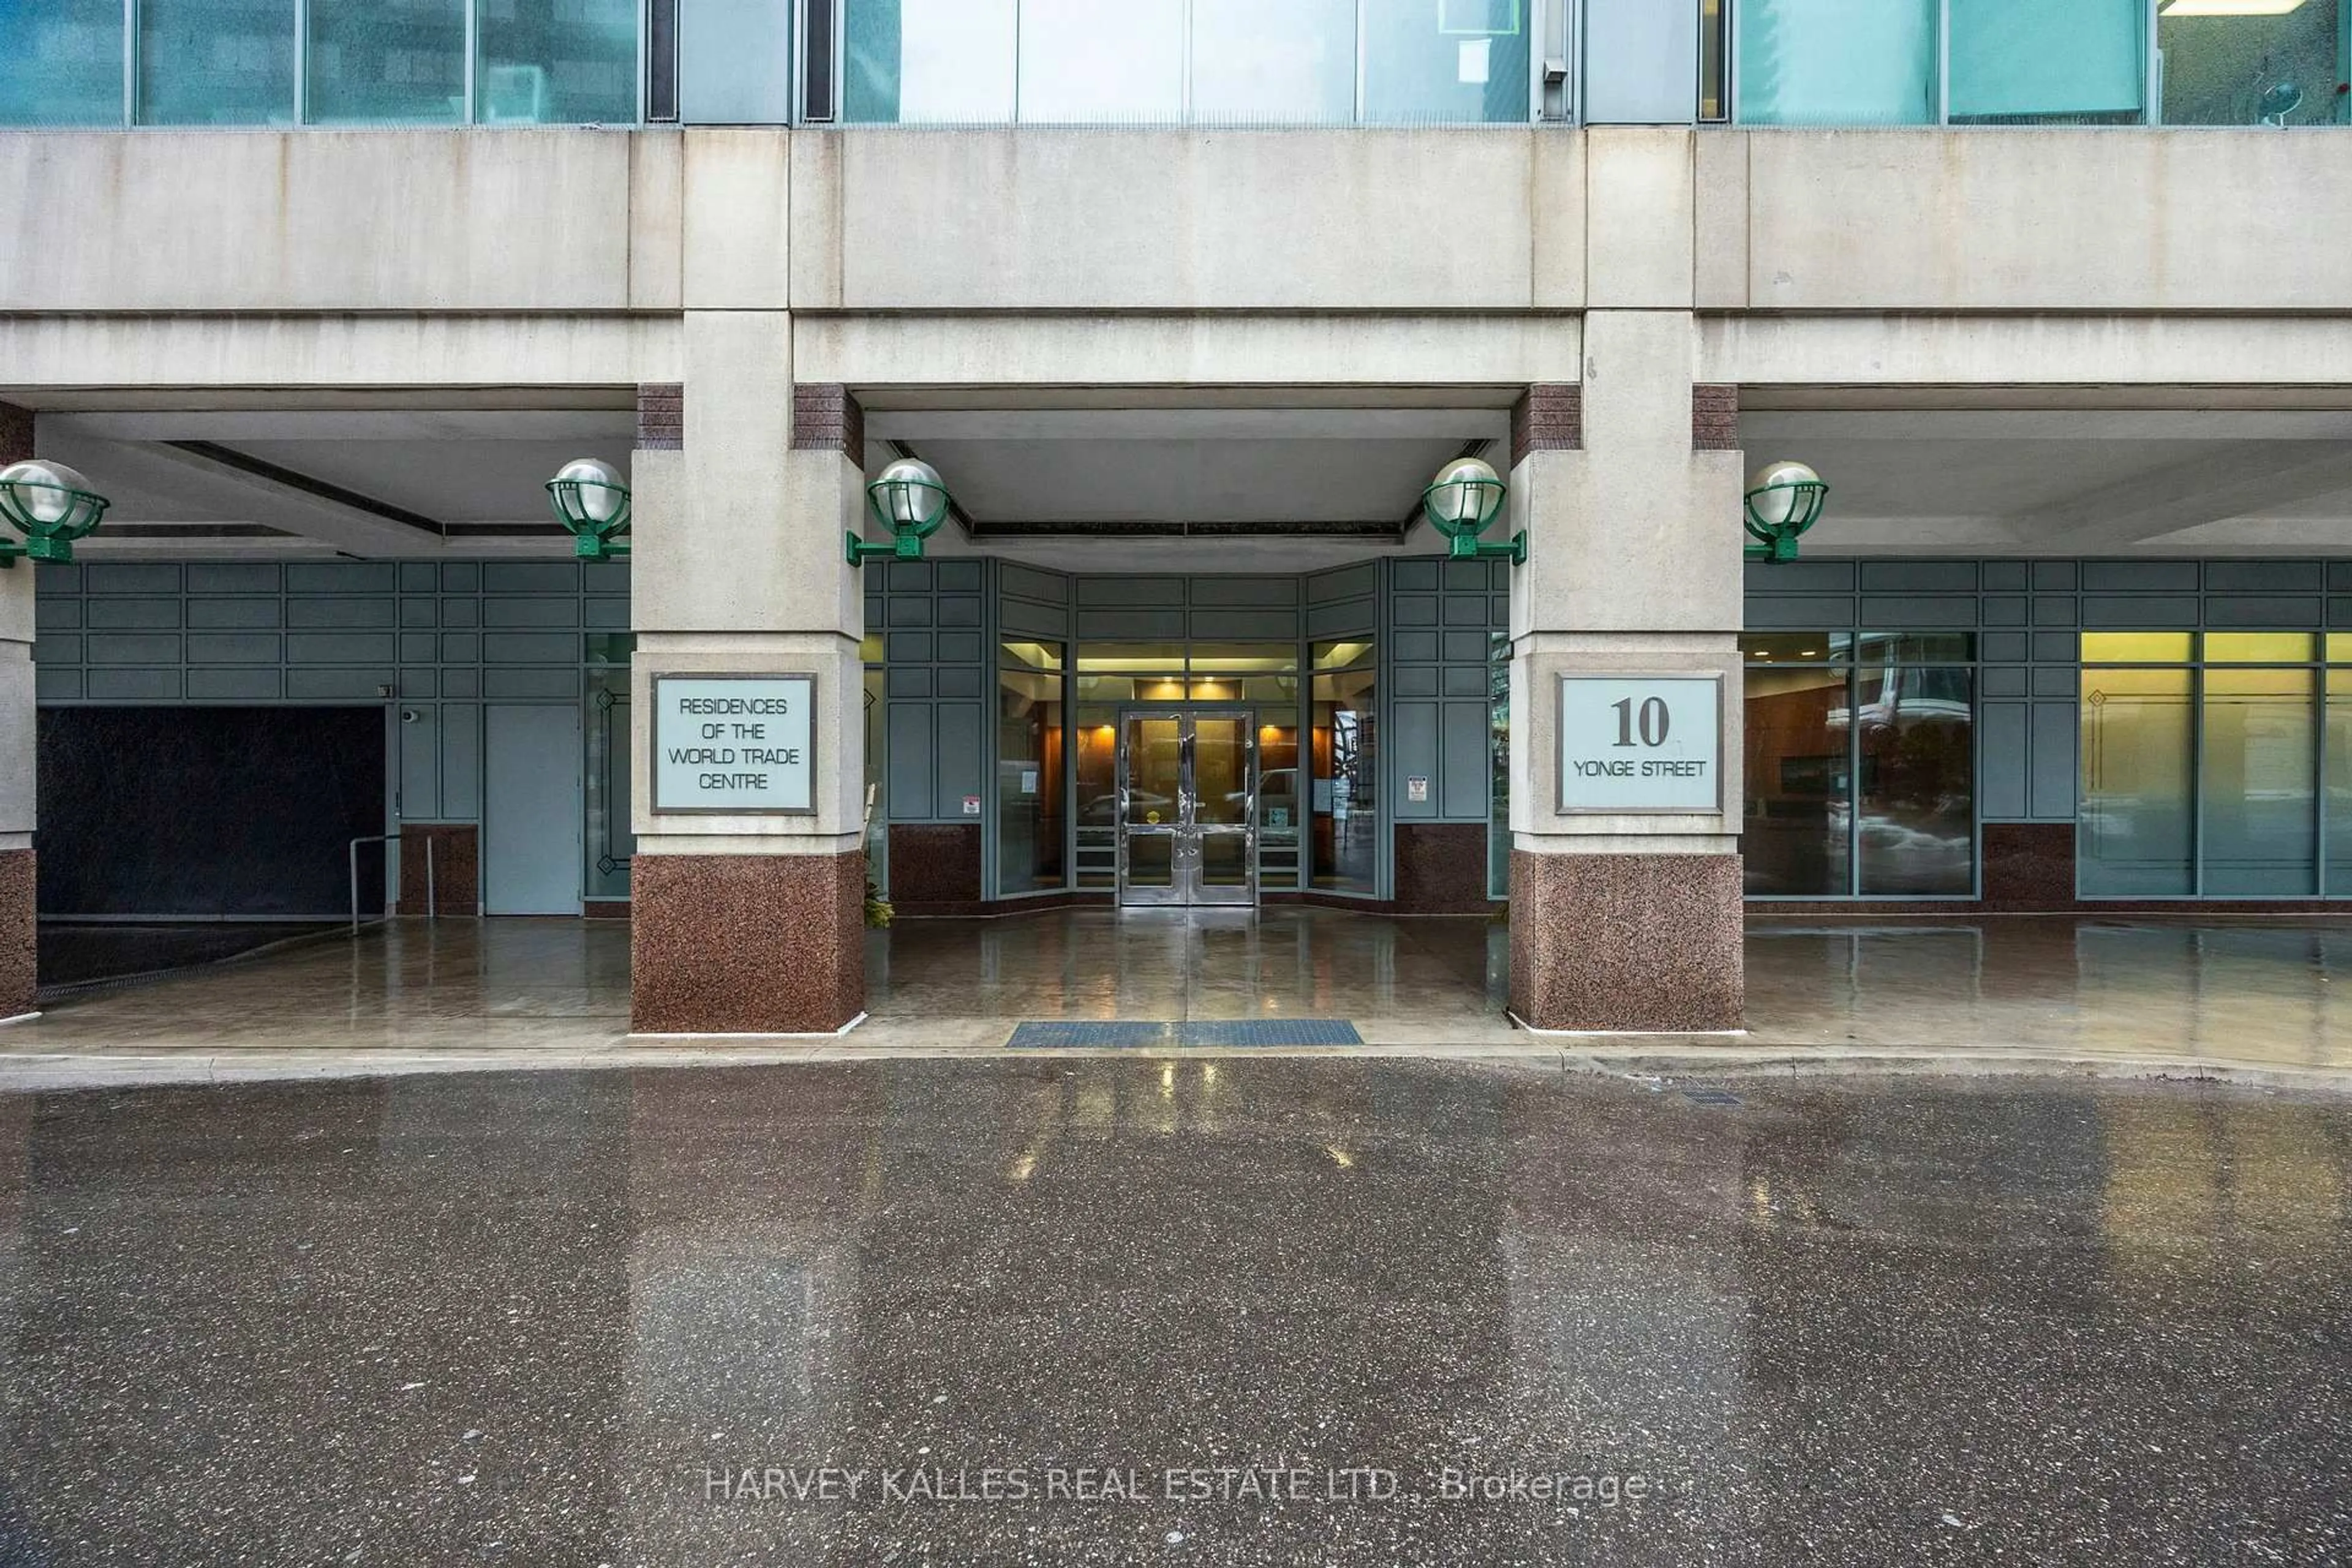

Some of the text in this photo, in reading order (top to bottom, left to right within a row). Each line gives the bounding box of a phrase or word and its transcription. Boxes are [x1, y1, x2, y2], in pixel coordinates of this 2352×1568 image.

[680, 698, 787, 714] RESIDENCES
[1610, 696, 1670, 747] 10
[702, 724, 765, 739] OF THE
[669, 748, 799, 764] WORLD TRADE
[1574, 761, 1706, 776] YONGE STREET
[699, 774, 768, 790] CENTRE
